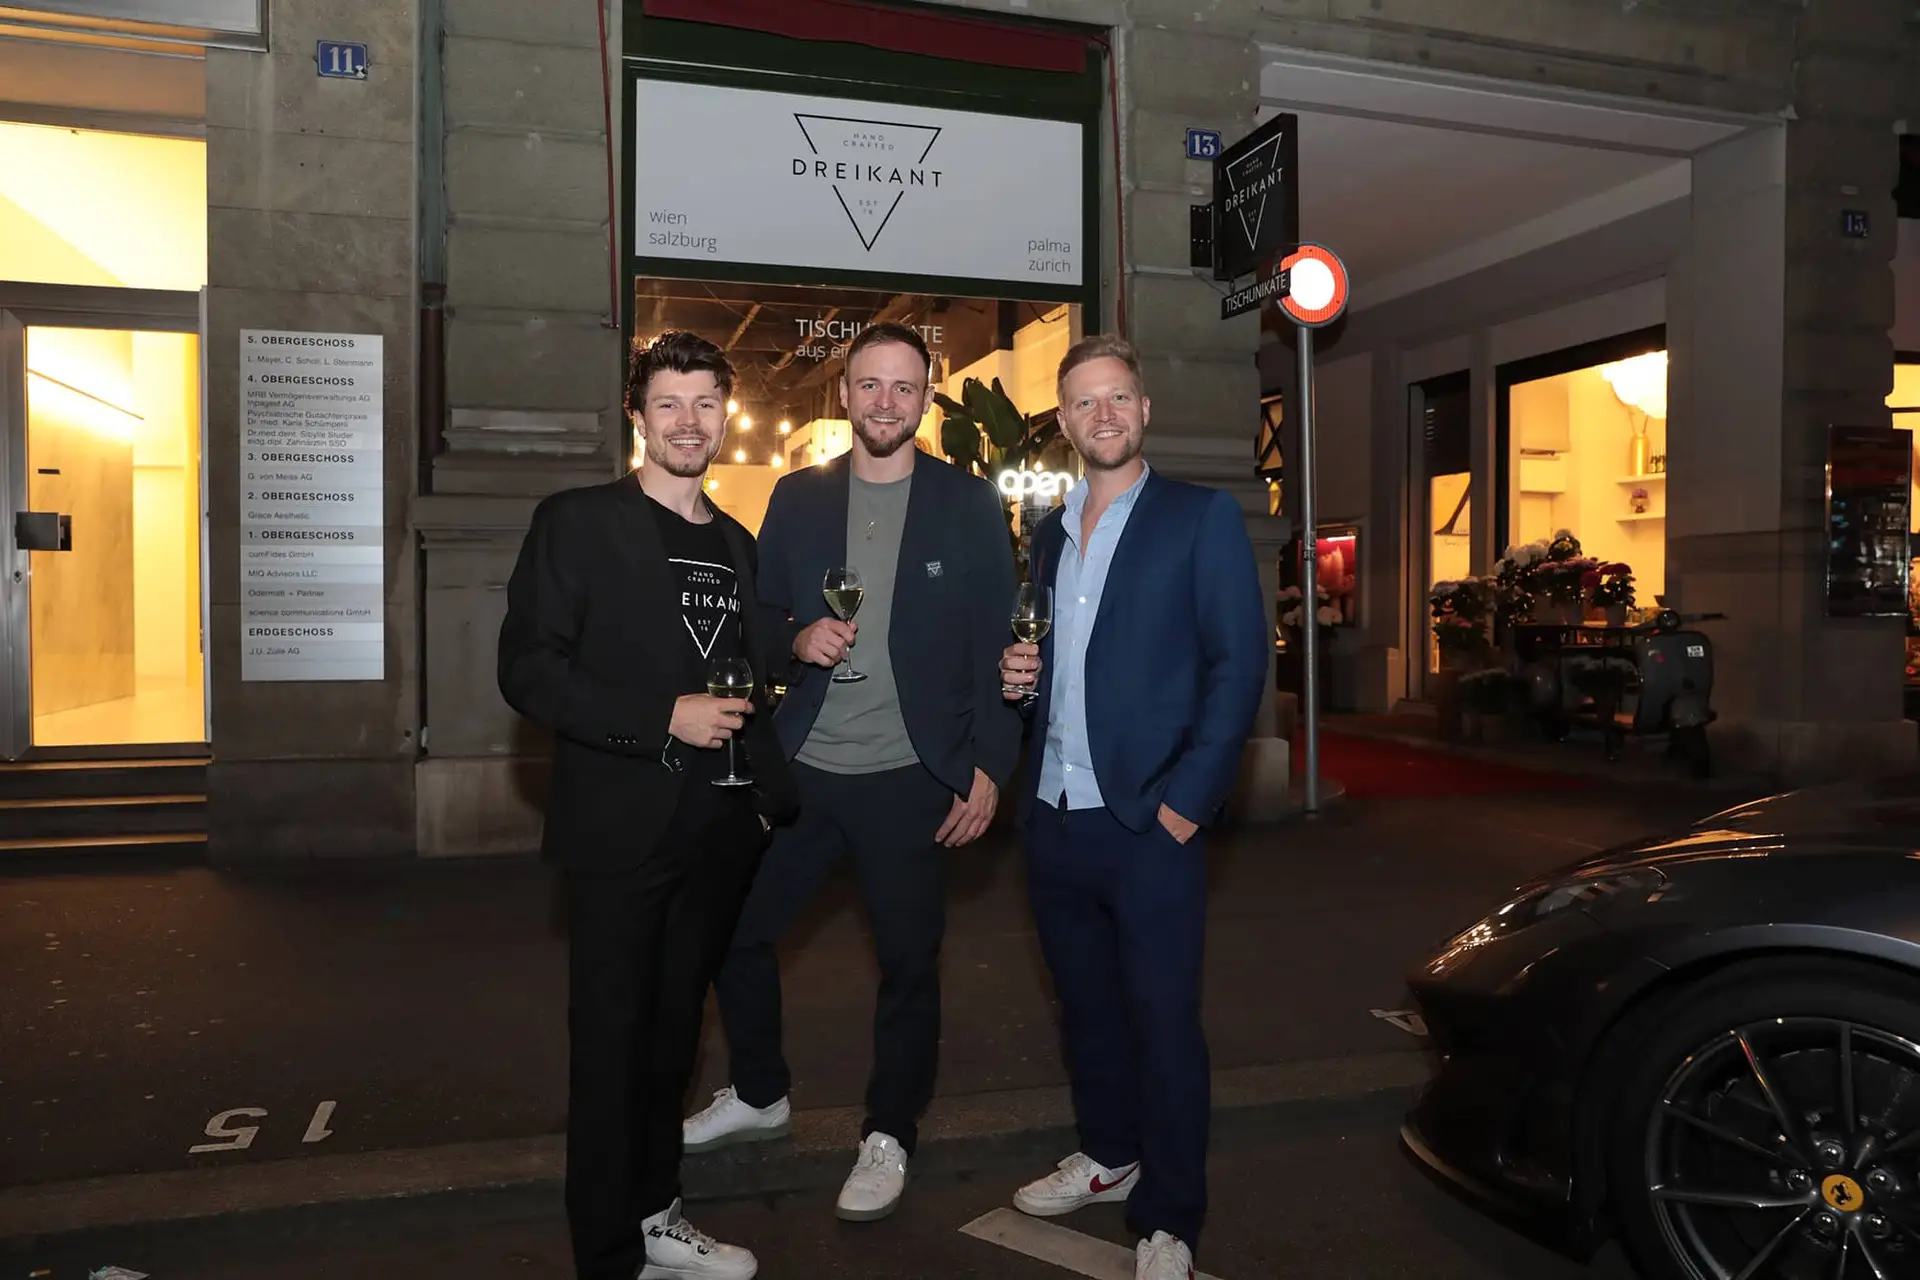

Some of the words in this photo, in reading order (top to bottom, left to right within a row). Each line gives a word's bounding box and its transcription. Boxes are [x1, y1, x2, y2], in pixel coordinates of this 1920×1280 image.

[329, 46, 354, 73] 11
[853, 133, 885, 141] HAND
[843, 140, 894, 150] CRAFTED
[1192, 134, 1215, 156] 13
[792, 158, 942, 187] DREIKANT
[1225, 167, 1283, 212] DREIKANT
[649, 208, 687, 225] wien
[648, 230, 717, 253] salzburg
[1028, 238, 1071, 254] palma
[1028, 258, 1071, 273] zürich
[1225, 272, 1286, 312] TISCHUNIKATE
[247, 336, 257, 344] 5.
[261, 336, 355, 348] OBERGESCHOSS
[796, 344, 826, 358] aus
[247, 375, 257, 383] 4.
[261, 375, 354, 386] OBERGESCHOSS
[359, 394, 371, 402] AG
[282, 400, 295, 408] AG
[247, 453, 257, 461] 3.
[261, 453, 354, 463] OBERGESCHOSS
[300, 473, 313, 481] AG
[998, 468, 1074, 503] open
[247, 492, 257, 500] 2.
[261, 492, 354, 502] OBERGESCHOSS
[274, 511, 310, 520] Aesthetic
[248, 531, 257, 539] 1.
[261, 531, 354, 540] OBERGESCHOSS
[687, 575, 721, 584] CRAFTED
[297, 589, 325, 597] Partner
[681, 591, 740, 613] EIKAN
[248, 628, 334, 637] ERDGESCHOSS
[287, 647, 300, 655] AG
